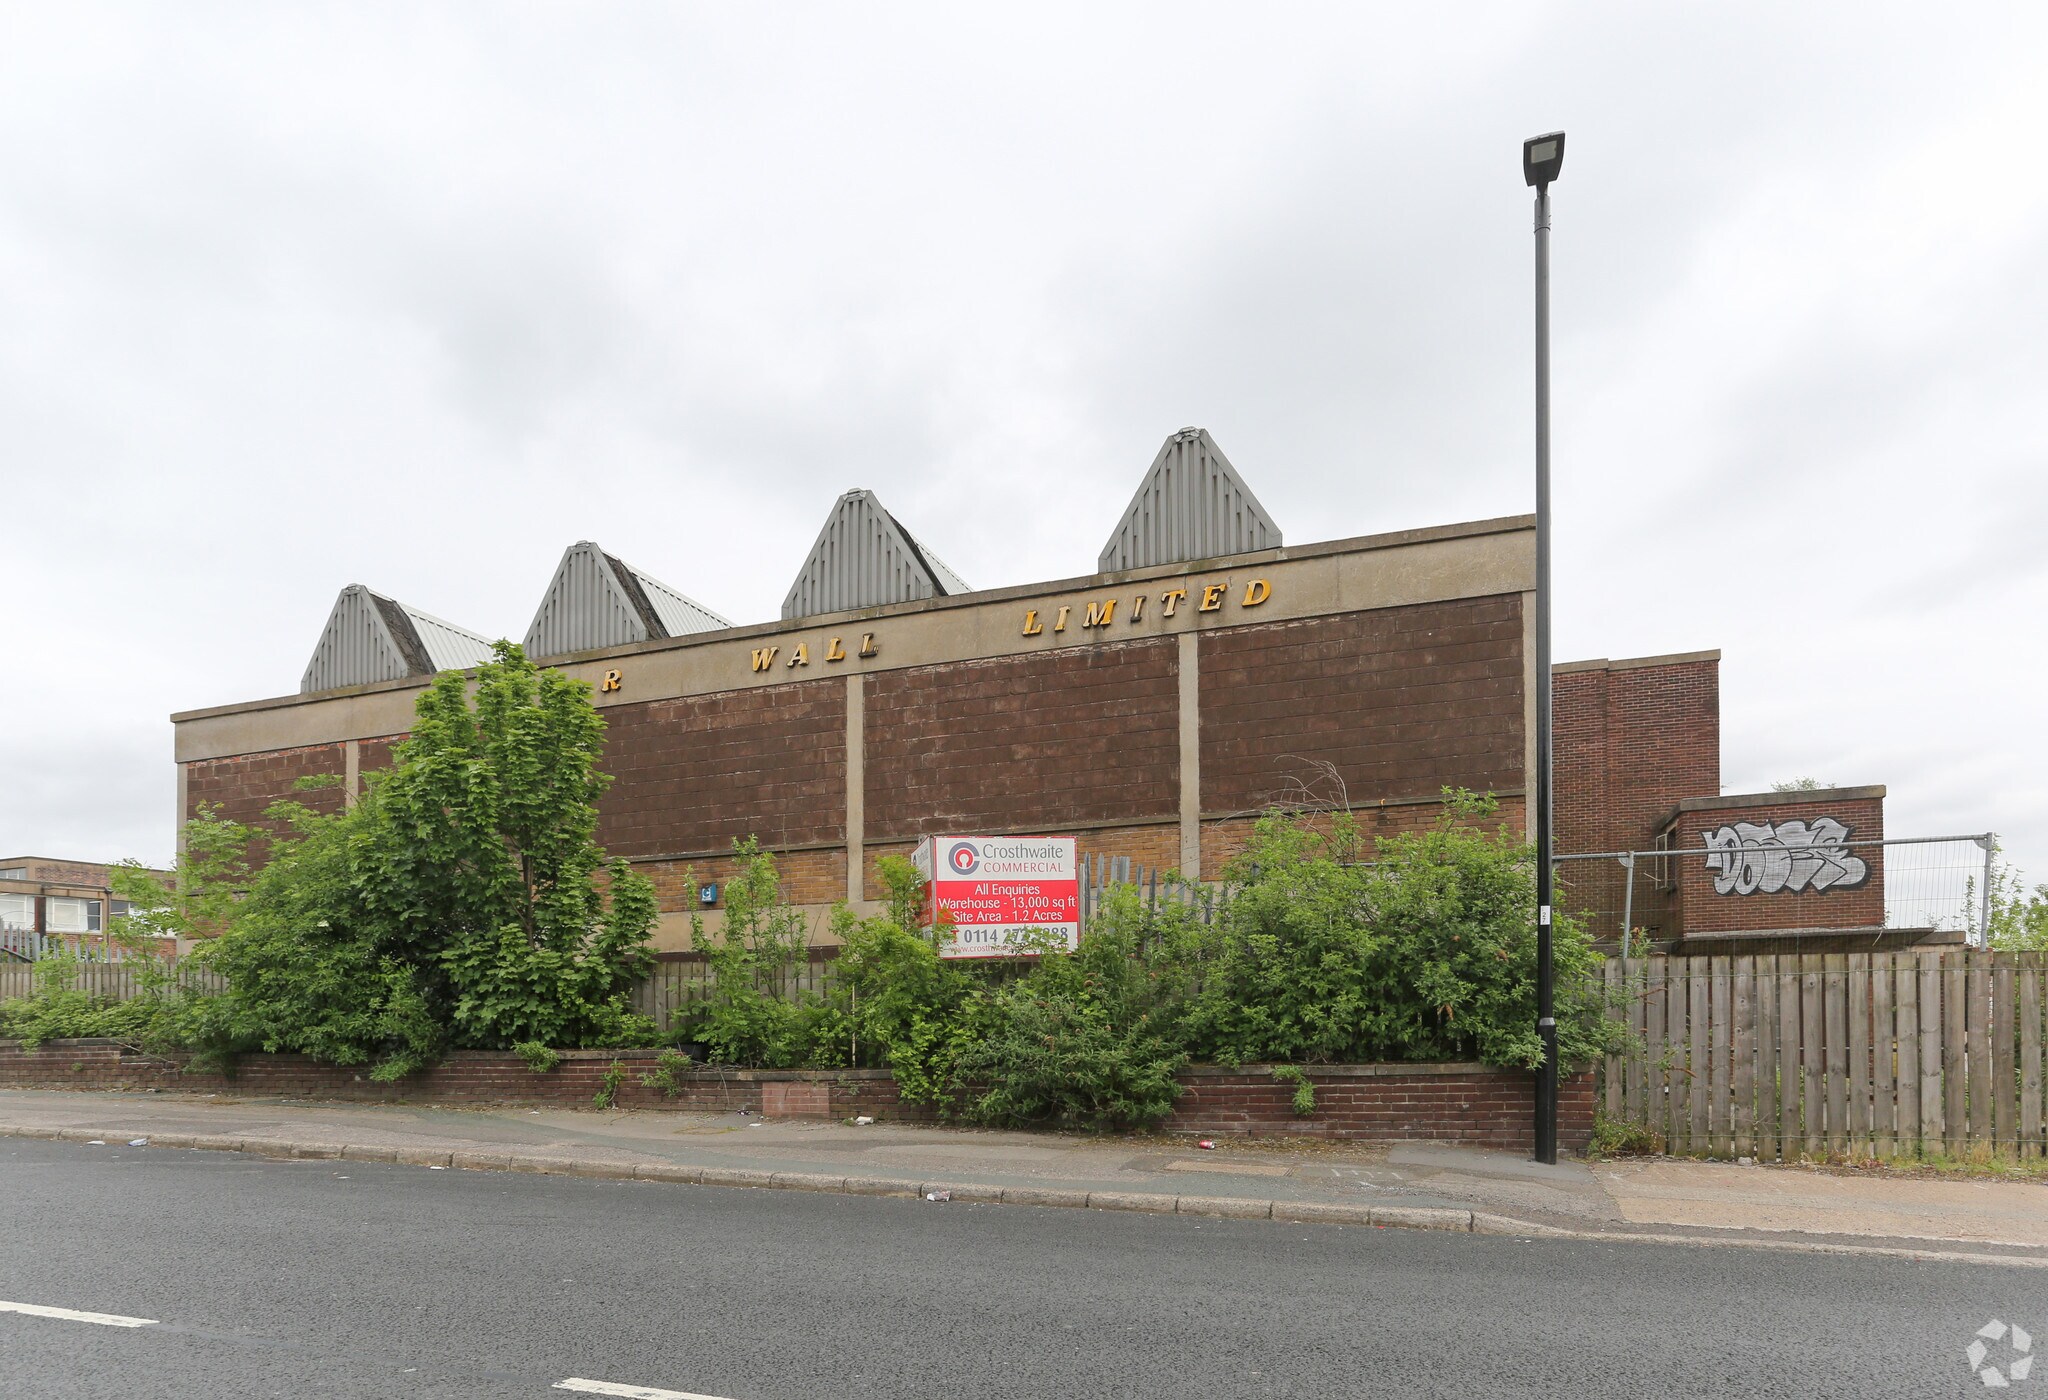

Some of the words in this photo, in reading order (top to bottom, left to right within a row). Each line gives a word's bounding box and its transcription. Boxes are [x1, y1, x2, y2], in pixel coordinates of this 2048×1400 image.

[751, 632, 879, 673] WALL
[1022, 578, 1272, 637] LIMITED
[983, 843, 1063, 859] Crosthwaite
[983, 862, 1063, 873] COMMERCIAL
[975, 884, 989, 895] All
[992, 884, 1040, 898] Enquiries
[938, 898, 1001, 909] Warehouse
[1011, 897, 1049, 909] 13,000
[1052, 899, 1065, 910] sq
[1067, 896, 1076, 907] ft
[953, 911, 974, 923] Site
[976, 911, 1002, 922] Area
[1012, 910, 1029, 921] 1.2
[1032, 910, 1063, 921] Acres
[963, 929, 998, 943] 0114
